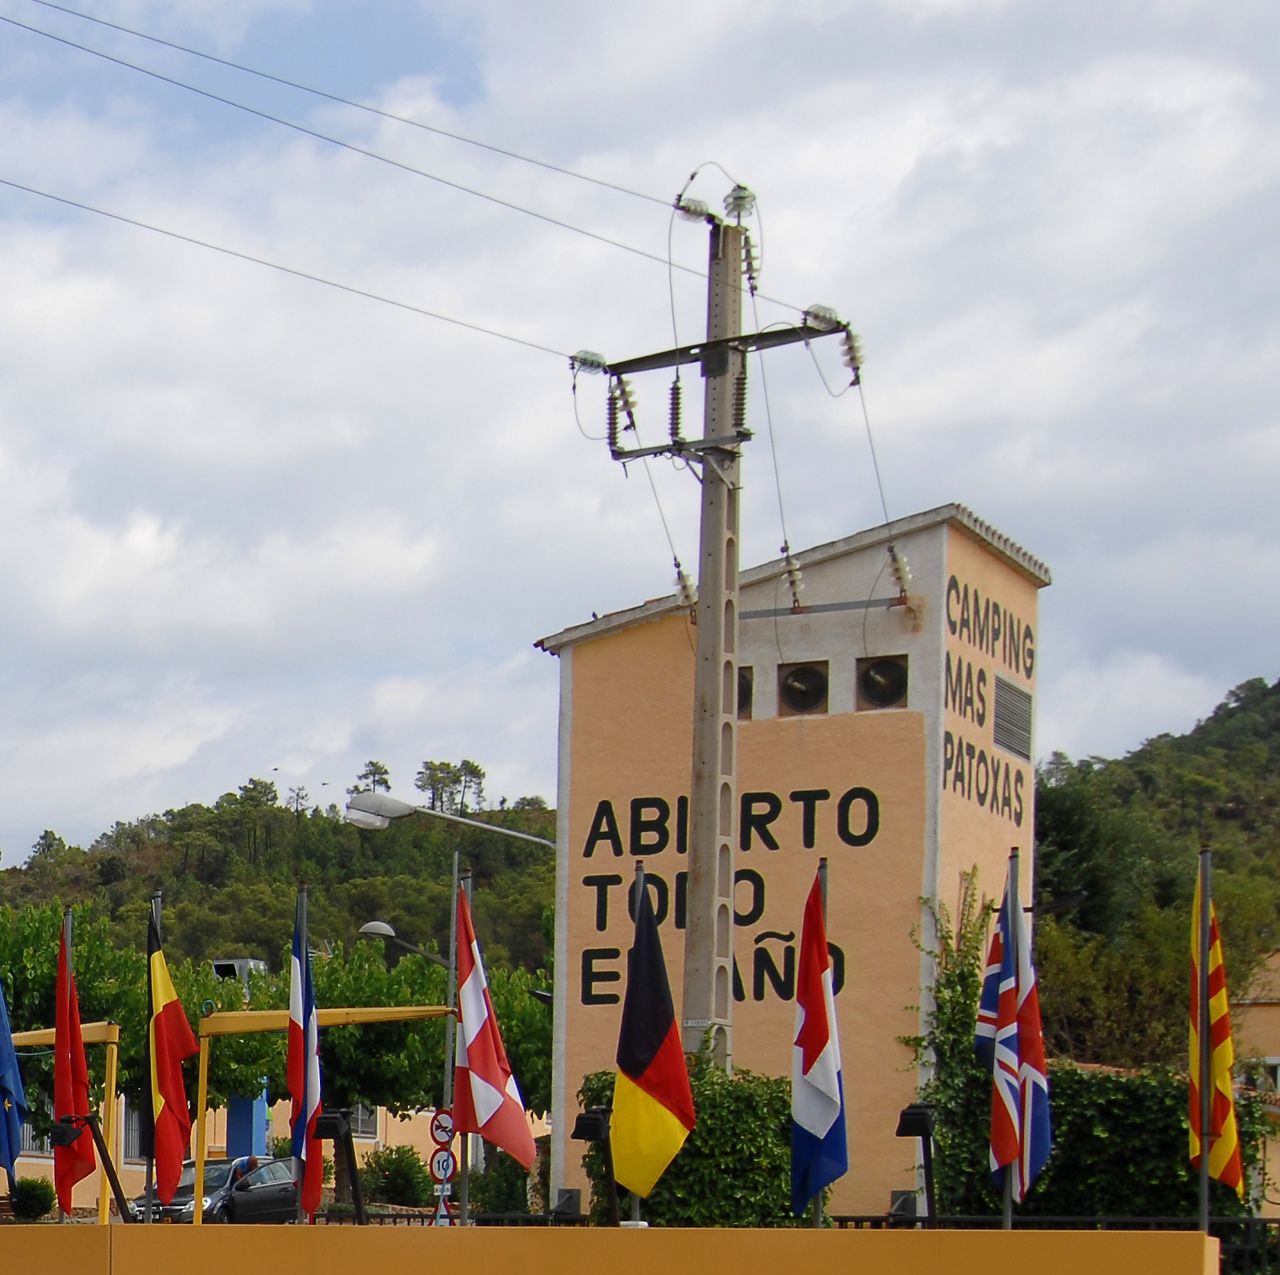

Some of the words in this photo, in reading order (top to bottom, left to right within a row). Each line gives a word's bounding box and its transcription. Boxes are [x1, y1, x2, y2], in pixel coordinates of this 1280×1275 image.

[946, 574, 1034, 680] CAMPING
[945, 651, 986, 728] MAS
[943, 730, 1024, 828] PATOXAS
[582, 787, 880, 858] ABIRTO
[436, 1159, 450, 1172] 10
